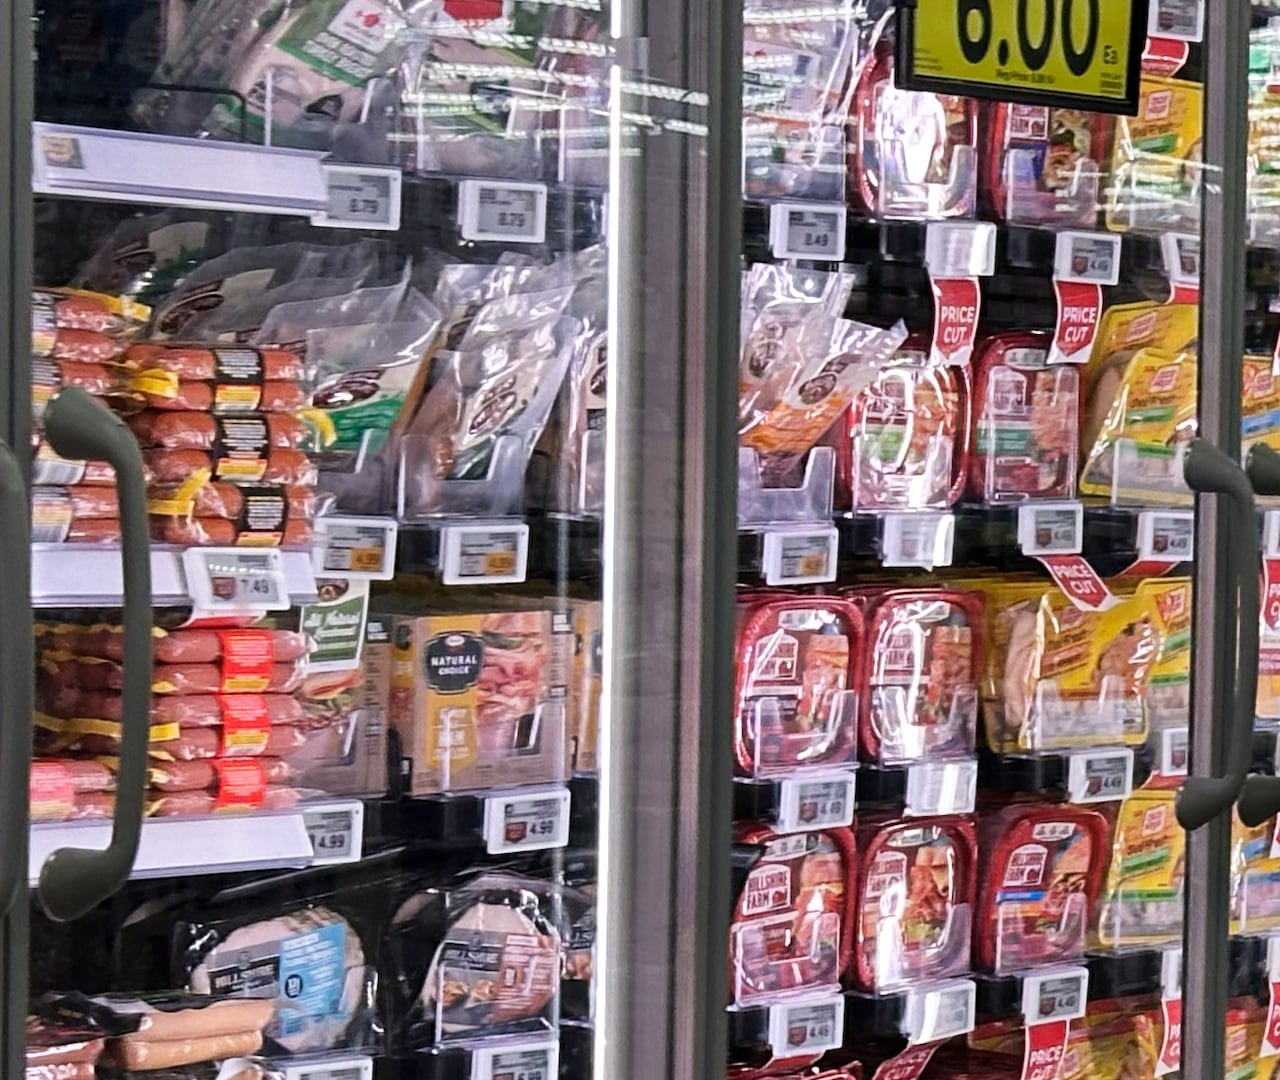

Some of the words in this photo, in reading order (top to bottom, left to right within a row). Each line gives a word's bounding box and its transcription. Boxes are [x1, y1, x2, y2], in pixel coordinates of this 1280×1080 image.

[941, 306, 976, 324] PRICE
[1061, 305, 1095, 324] PRICE
[944, 326, 968, 344] CUT
[1063, 326, 1088, 342] CUT
[1052, 563, 1092, 580] PRICE
[1070, 580, 1096, 595] CUT
[431, 654, 478, 667] NATURAL
[438, 666, 471, 676] CHOICE
[748, 870, 789, 891] HILLSHIRE
[747, 889, 770, 909] FARM
[1029, 1046, 1062, 1065] PRICE
